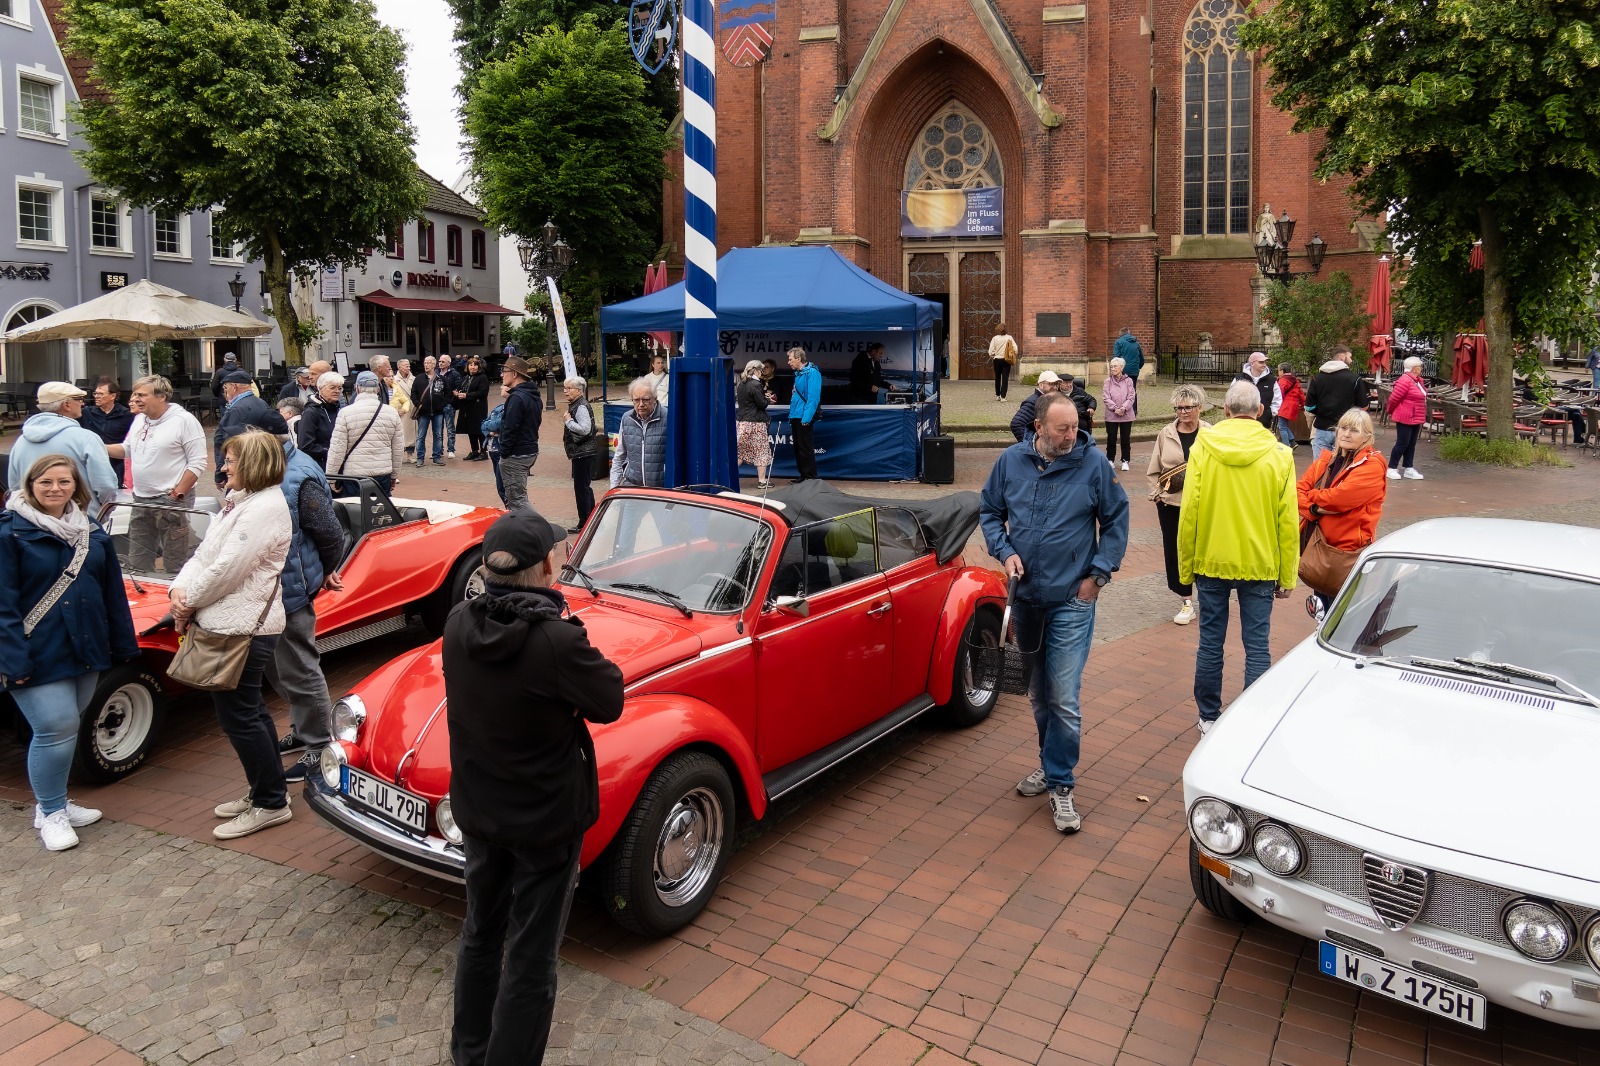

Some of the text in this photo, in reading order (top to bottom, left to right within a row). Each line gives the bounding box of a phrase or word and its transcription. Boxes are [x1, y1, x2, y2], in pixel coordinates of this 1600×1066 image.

[967, 209, 1000, 218] Im Fluss
[967, 217, 981, 225] des
[967, 224, 995, 232] Lebens
[107, 274, 125, 283] ESS
[745, 340, 813, 353] HALTERN
[816, 341, 843, 353] AM
[768, 434, 786, 445] AM
[140, 673, 162, 693] KELLY
[113, 753, 145, 773] SUPER
[349, 771, 426, 829] RE UL 79H
[1325, 961, 1332, 969] D
[1344, 953, 1474, 1023] W Z 175H
